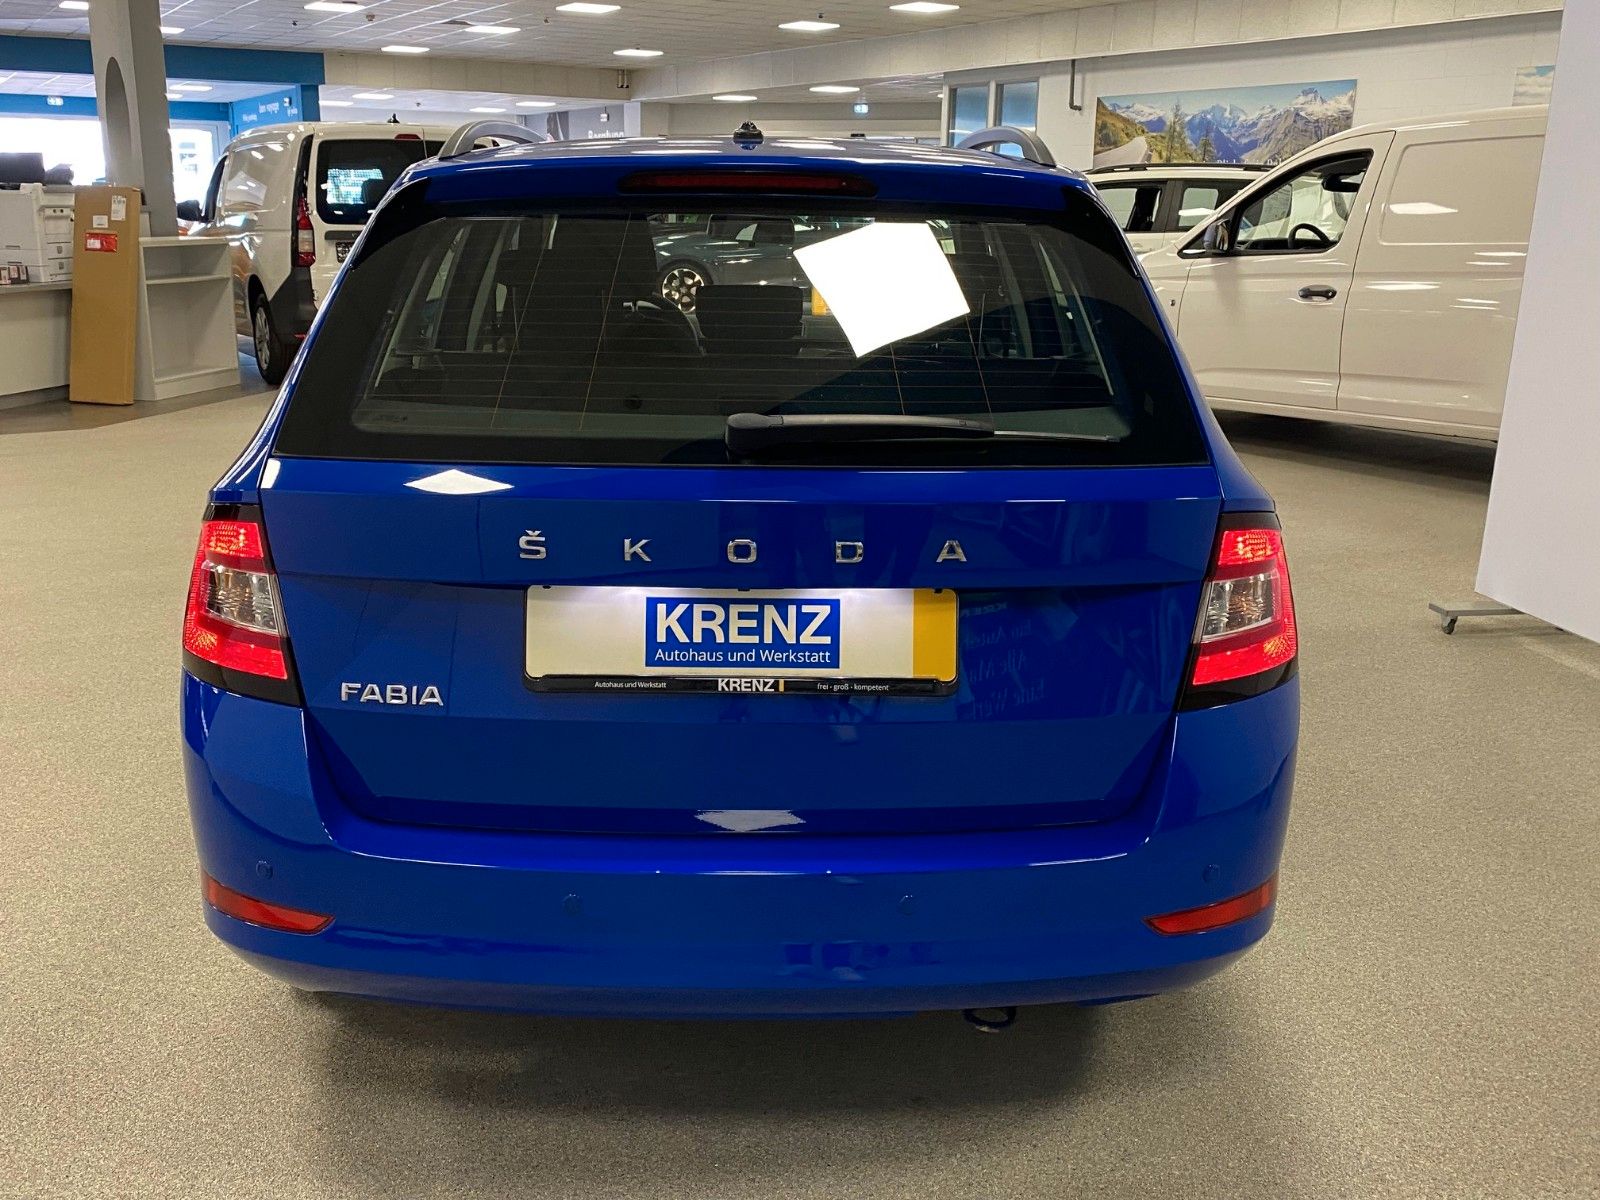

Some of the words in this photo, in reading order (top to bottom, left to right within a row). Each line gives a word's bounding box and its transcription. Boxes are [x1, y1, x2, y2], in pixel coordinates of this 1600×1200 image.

[518, 529, 968, 564] ŠKODA
[656, 603, 832, 644] KRENZ
[655, 648, 724, 662] Autohaus
[727, 649, 756, 662] und
[760, 649, 831, 663] Werkstatt
[637, 681, 667, 689] Werkstatt
[717, 678, 775, 692] KRENZ
[817, 682, 829, 690] frei
[833, 683, 849, 691] groß
[853, 683, 889, 692] kompetent
[341, 682, 444, 706] FABIA
